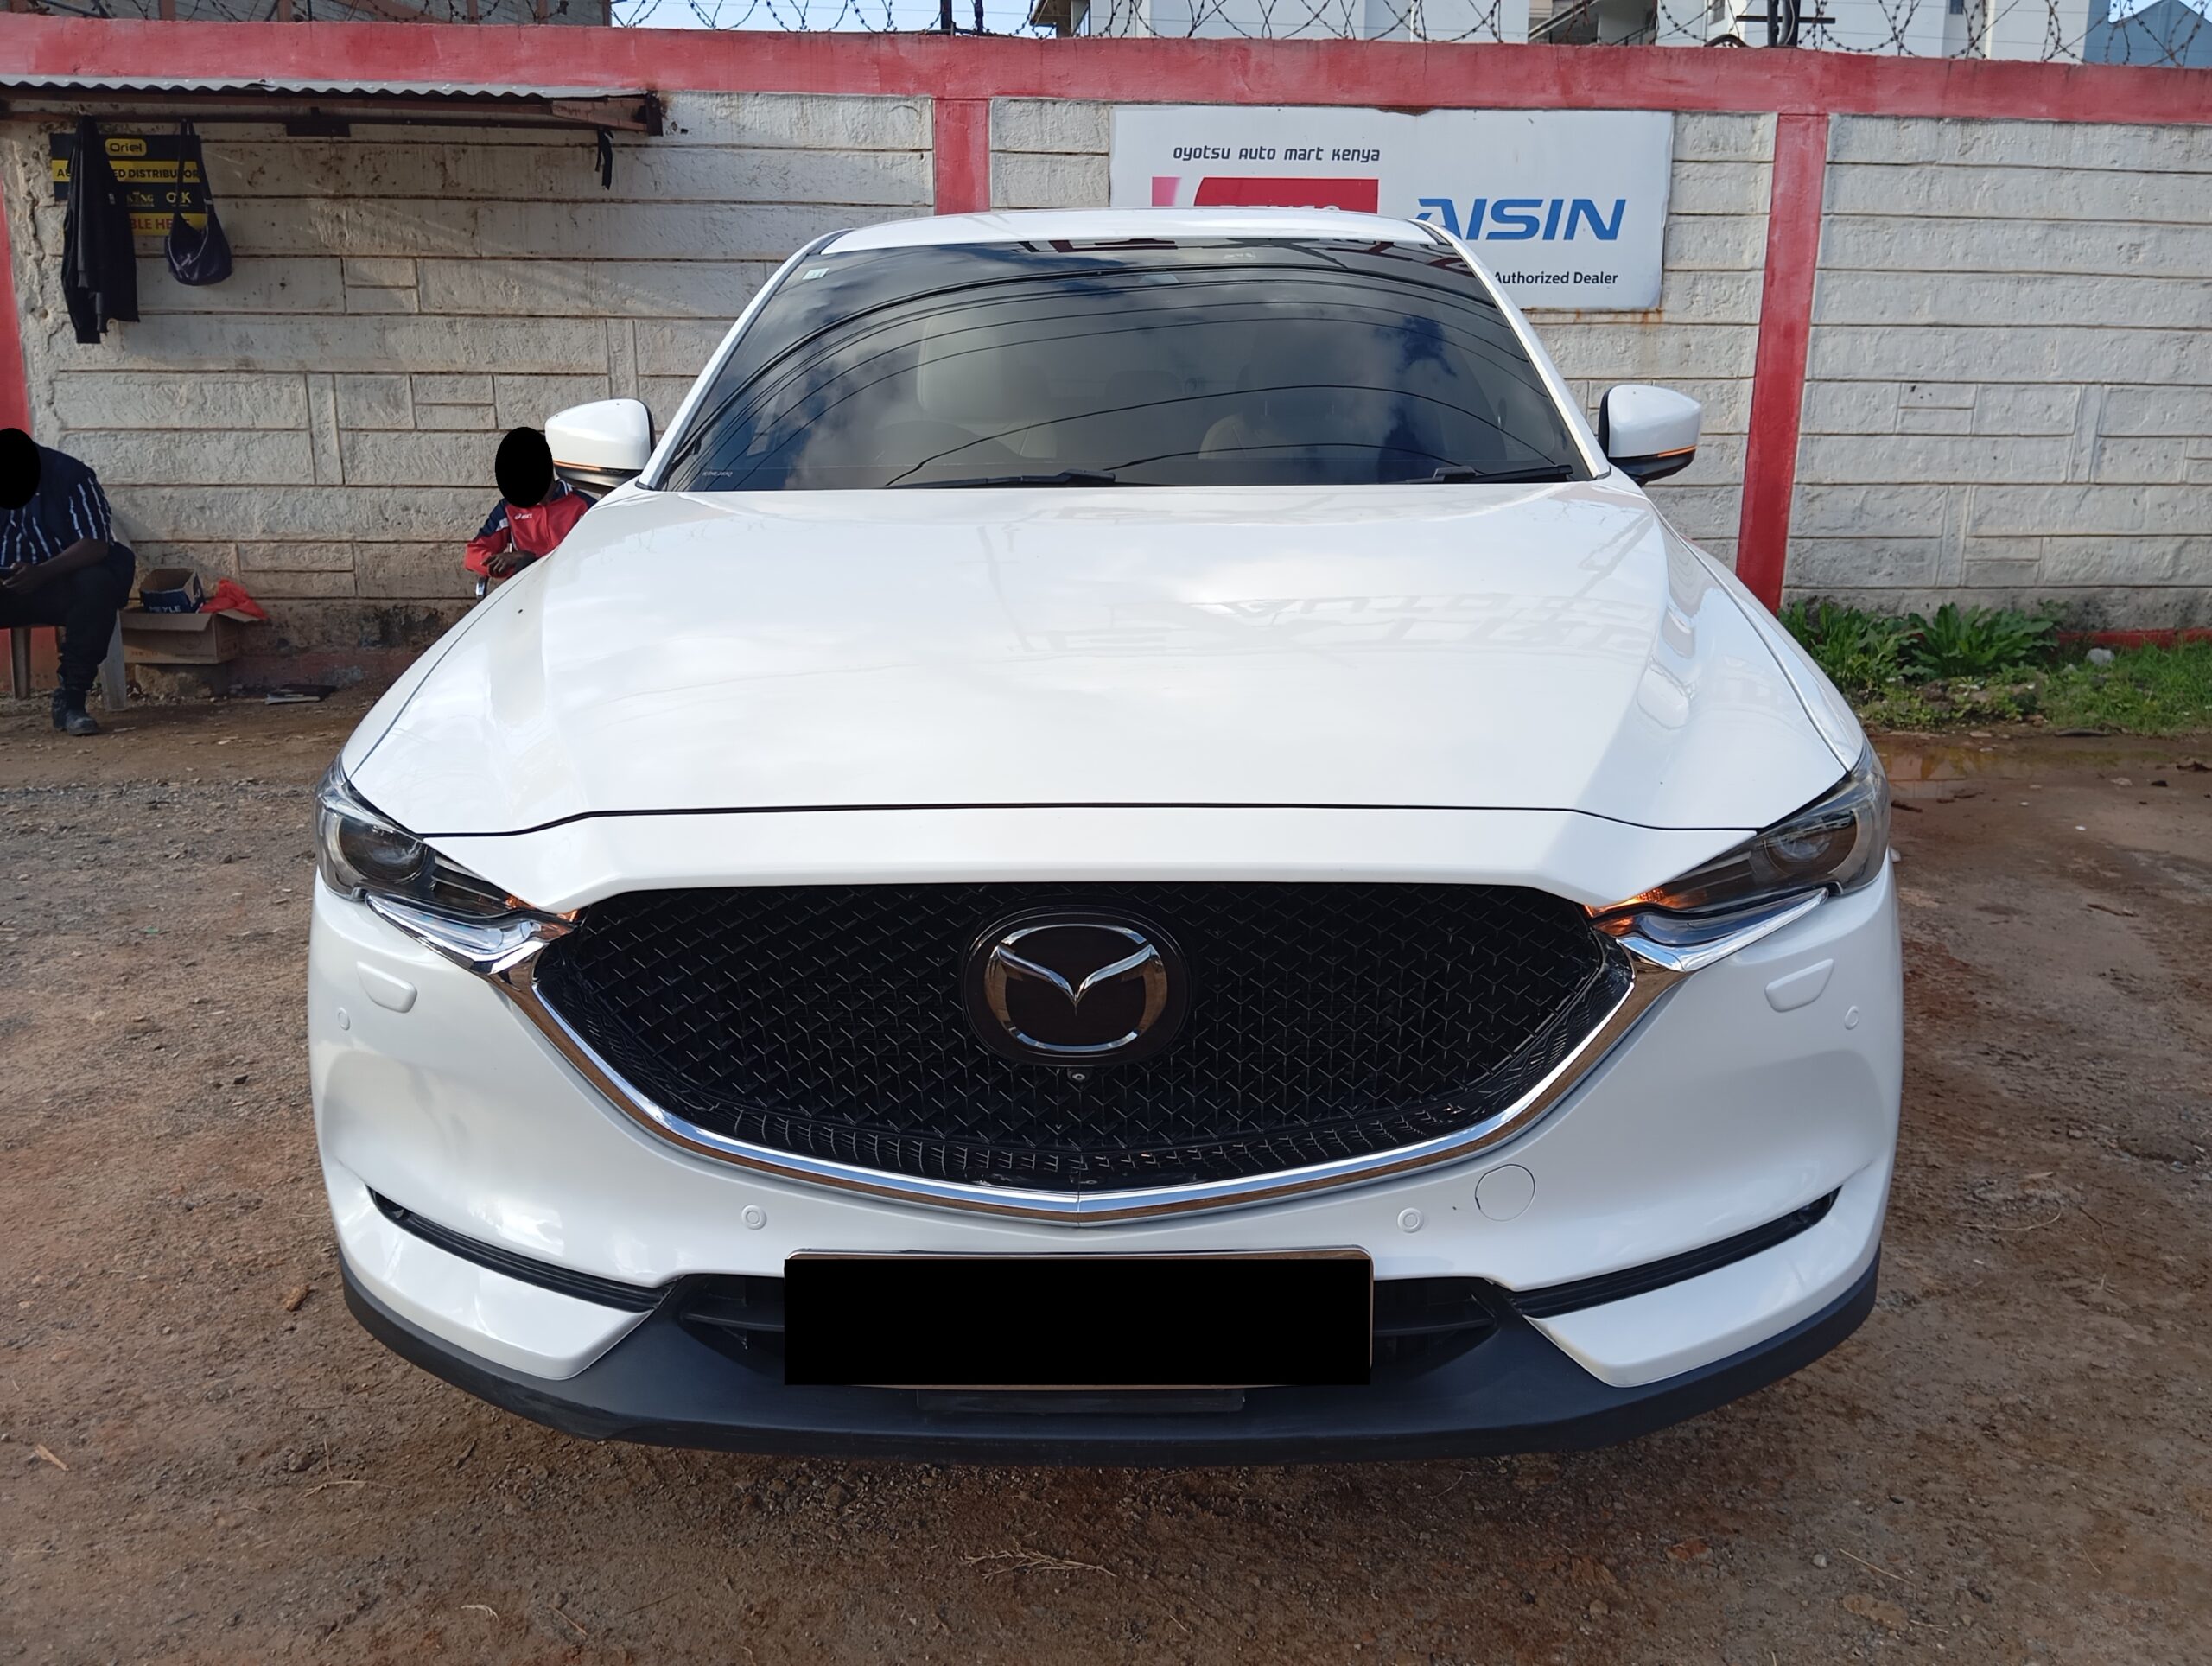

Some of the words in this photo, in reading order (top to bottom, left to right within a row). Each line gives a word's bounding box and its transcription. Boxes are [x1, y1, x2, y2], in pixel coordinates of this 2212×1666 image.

[110, 143, 143, 152] Oriel
[1173, 145, 1230, 162] oyotsu
[1284, 147, 1324, 161] mart
[129, 169, 200, 178] DISTRIBUOR
[1415, 198, 1627, 241] AISIN
[1493, 271, 1569, 284] Authorized
[1573, 271, 1618, 284] Dealer
